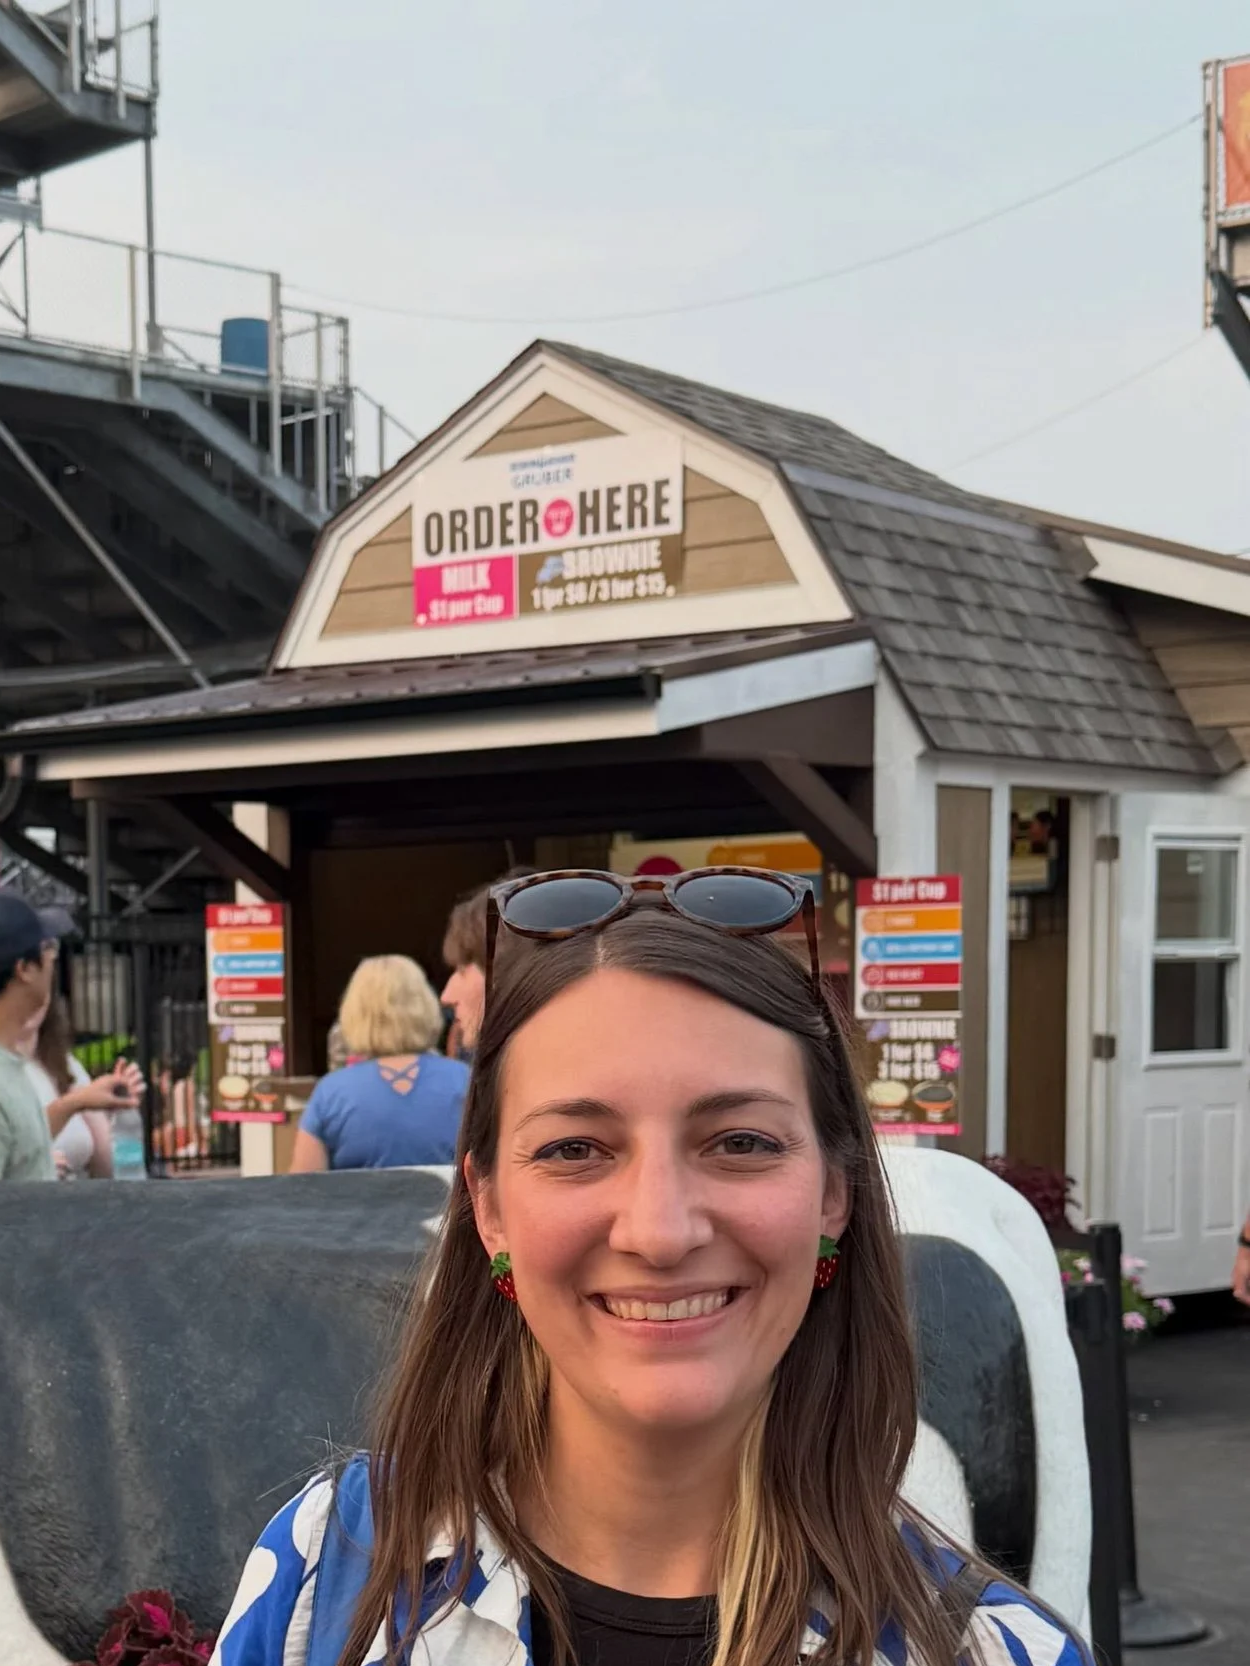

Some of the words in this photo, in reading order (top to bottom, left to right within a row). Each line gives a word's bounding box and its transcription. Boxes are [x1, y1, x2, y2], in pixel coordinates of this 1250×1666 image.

[424, 498, 540, 557] ORDER
[578, 478, 670, 536] HERE
[441, 561, 491, 595] MILK
